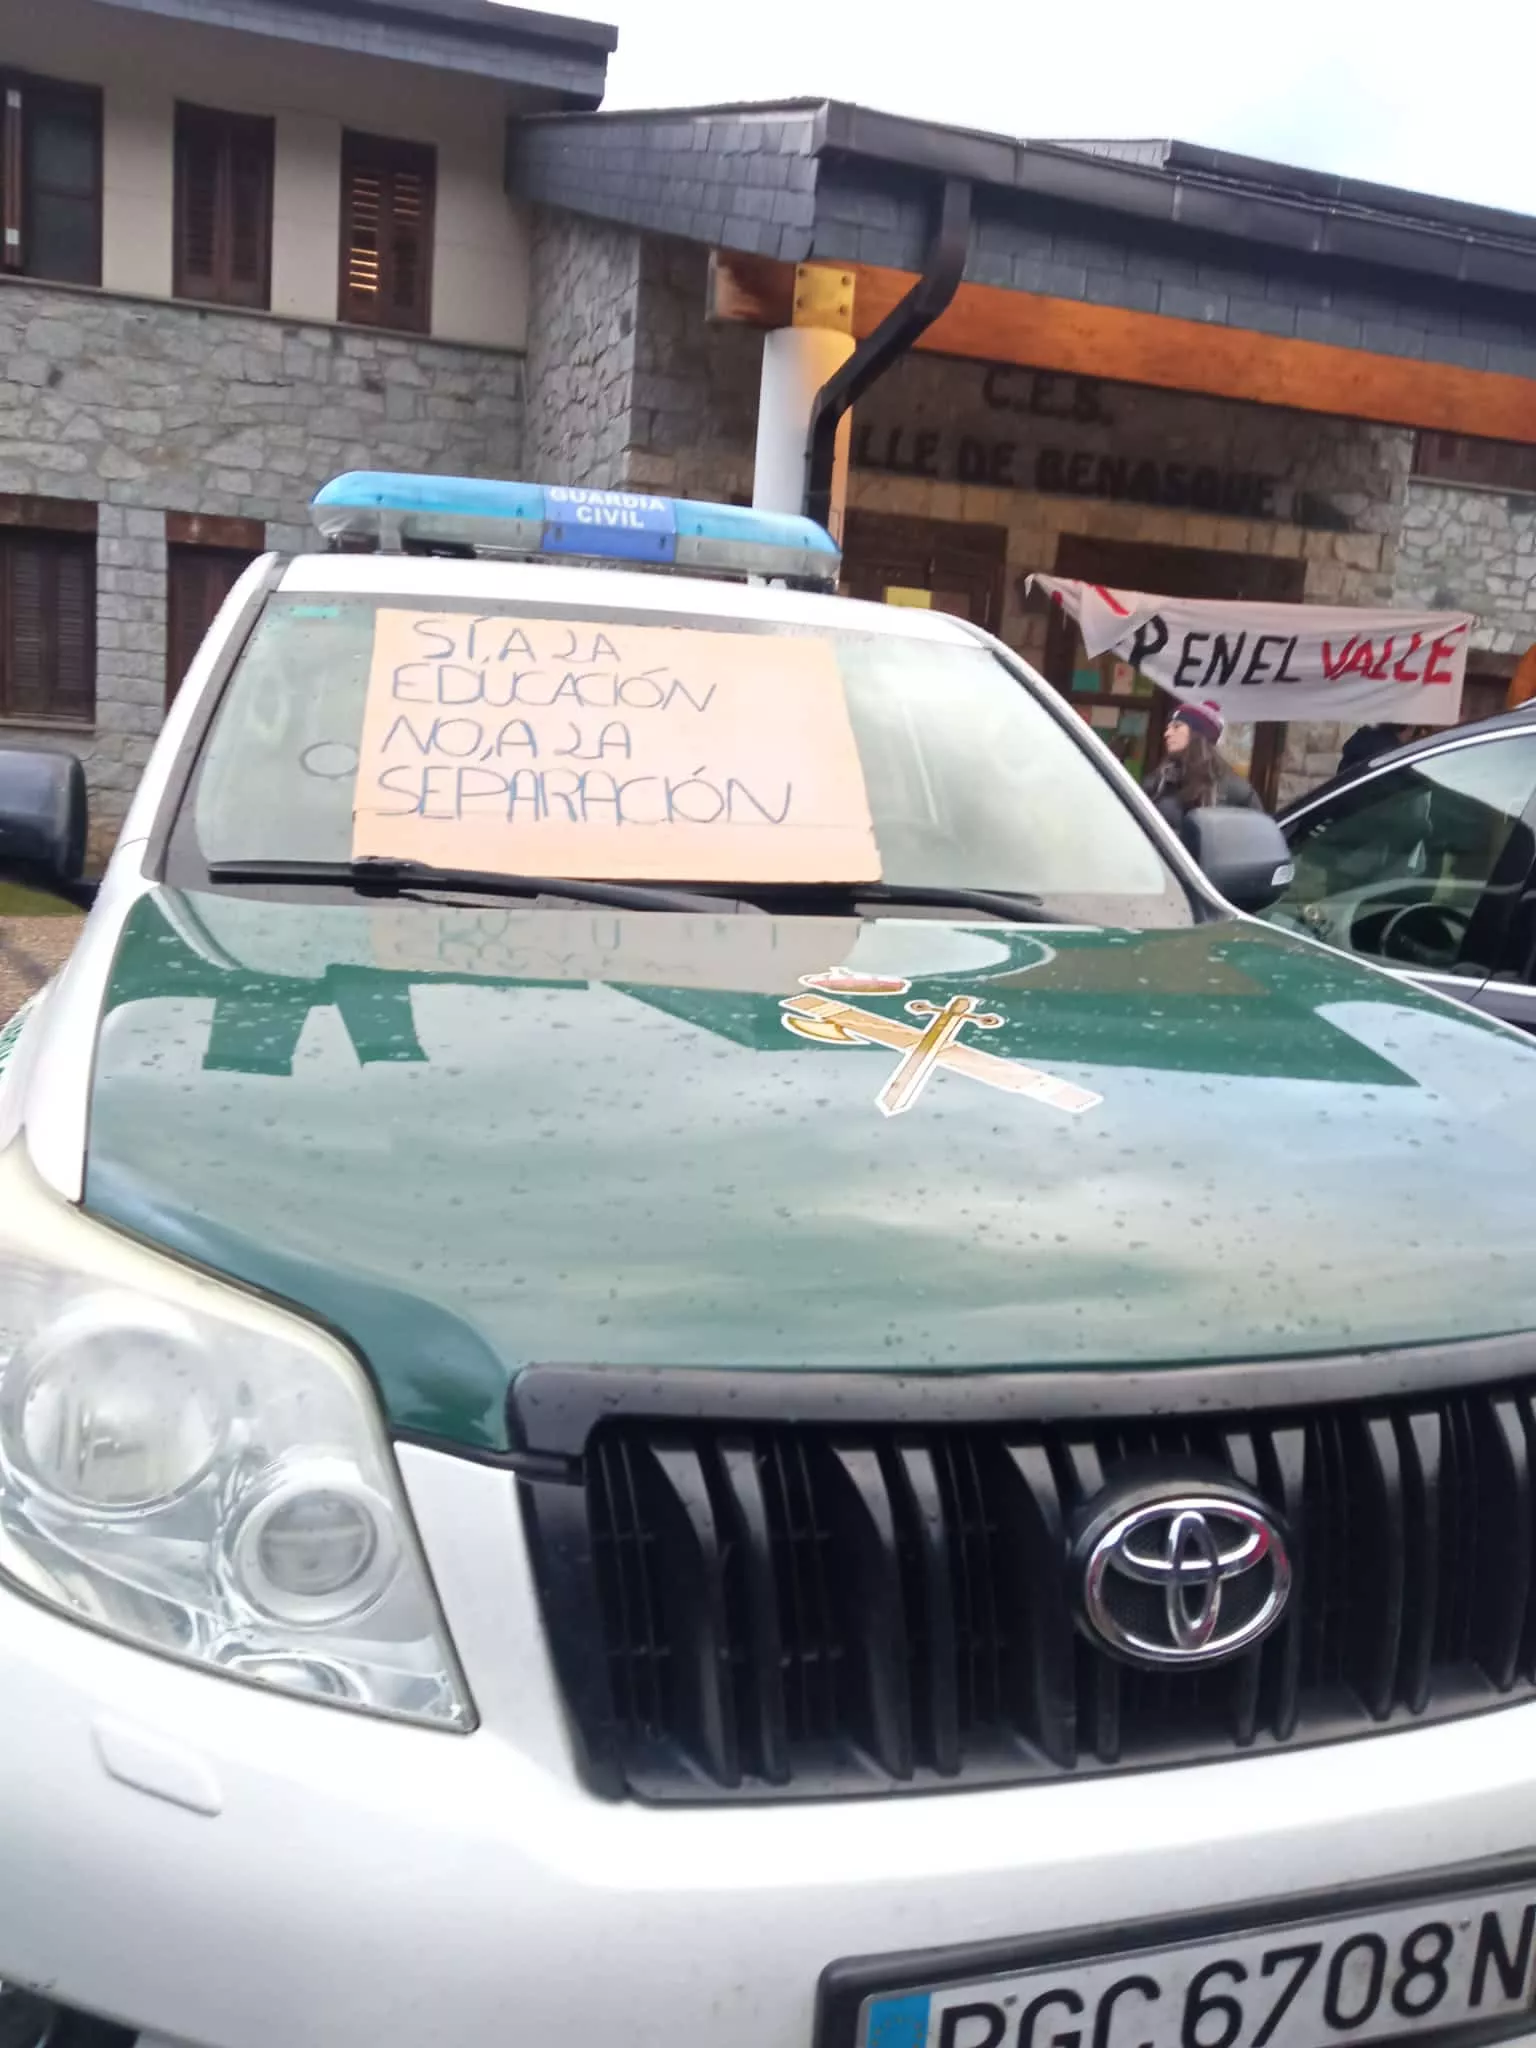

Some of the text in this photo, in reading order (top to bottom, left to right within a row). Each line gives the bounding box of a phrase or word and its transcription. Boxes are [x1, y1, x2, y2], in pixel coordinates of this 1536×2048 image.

[957, 434, 1017, 485] DE
[551, 486, 666, 513] GUARDIA
[575, 505, 645, 529] CIVIL
[1320, 623, 1468, 685] VALLE
[392, 662, 717, 712] EDUCACIÓN
[375, 765, 792, 826] SEPARACIÓN
